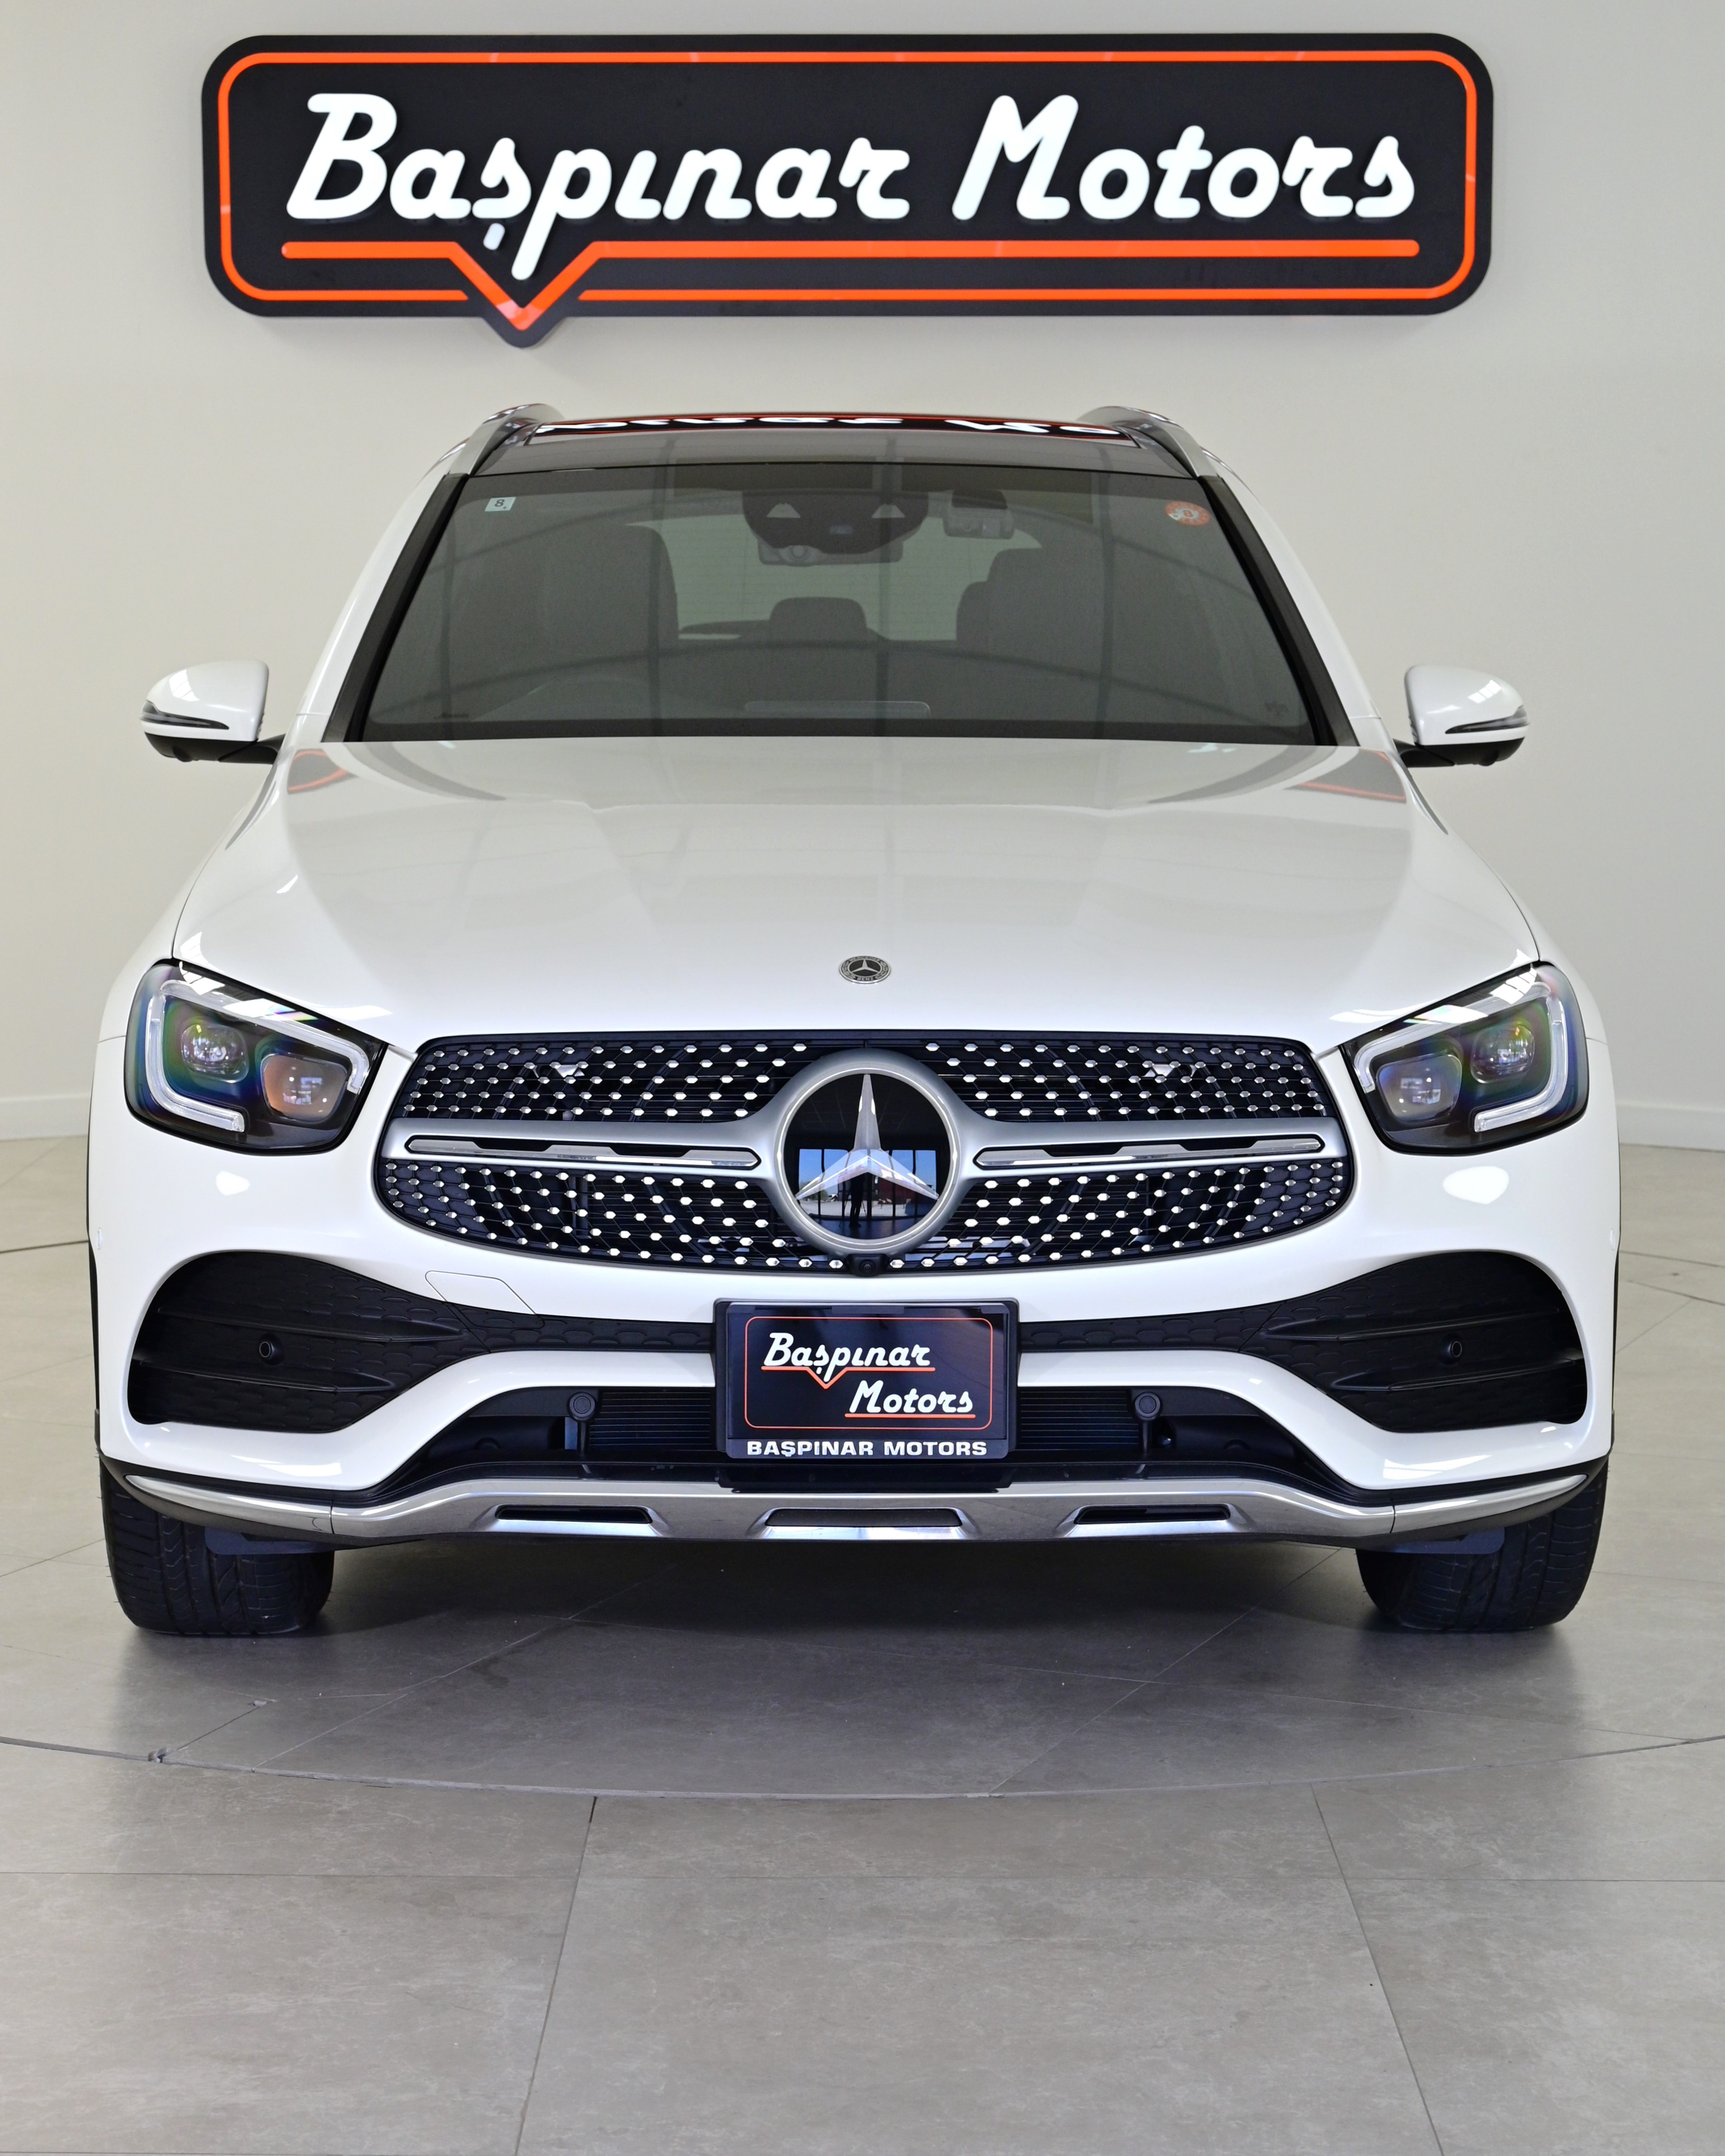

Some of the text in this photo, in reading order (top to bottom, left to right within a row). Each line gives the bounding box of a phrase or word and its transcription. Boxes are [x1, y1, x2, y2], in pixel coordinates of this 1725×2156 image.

[286, 93, 1414, 280] Başpınar Motors
[763, 1332, 930, 1382] Başpınar
[849, 1380, 973, 1413] Motors
[747, 1441, 987, 1457] BAŞPINAR MOTORS
